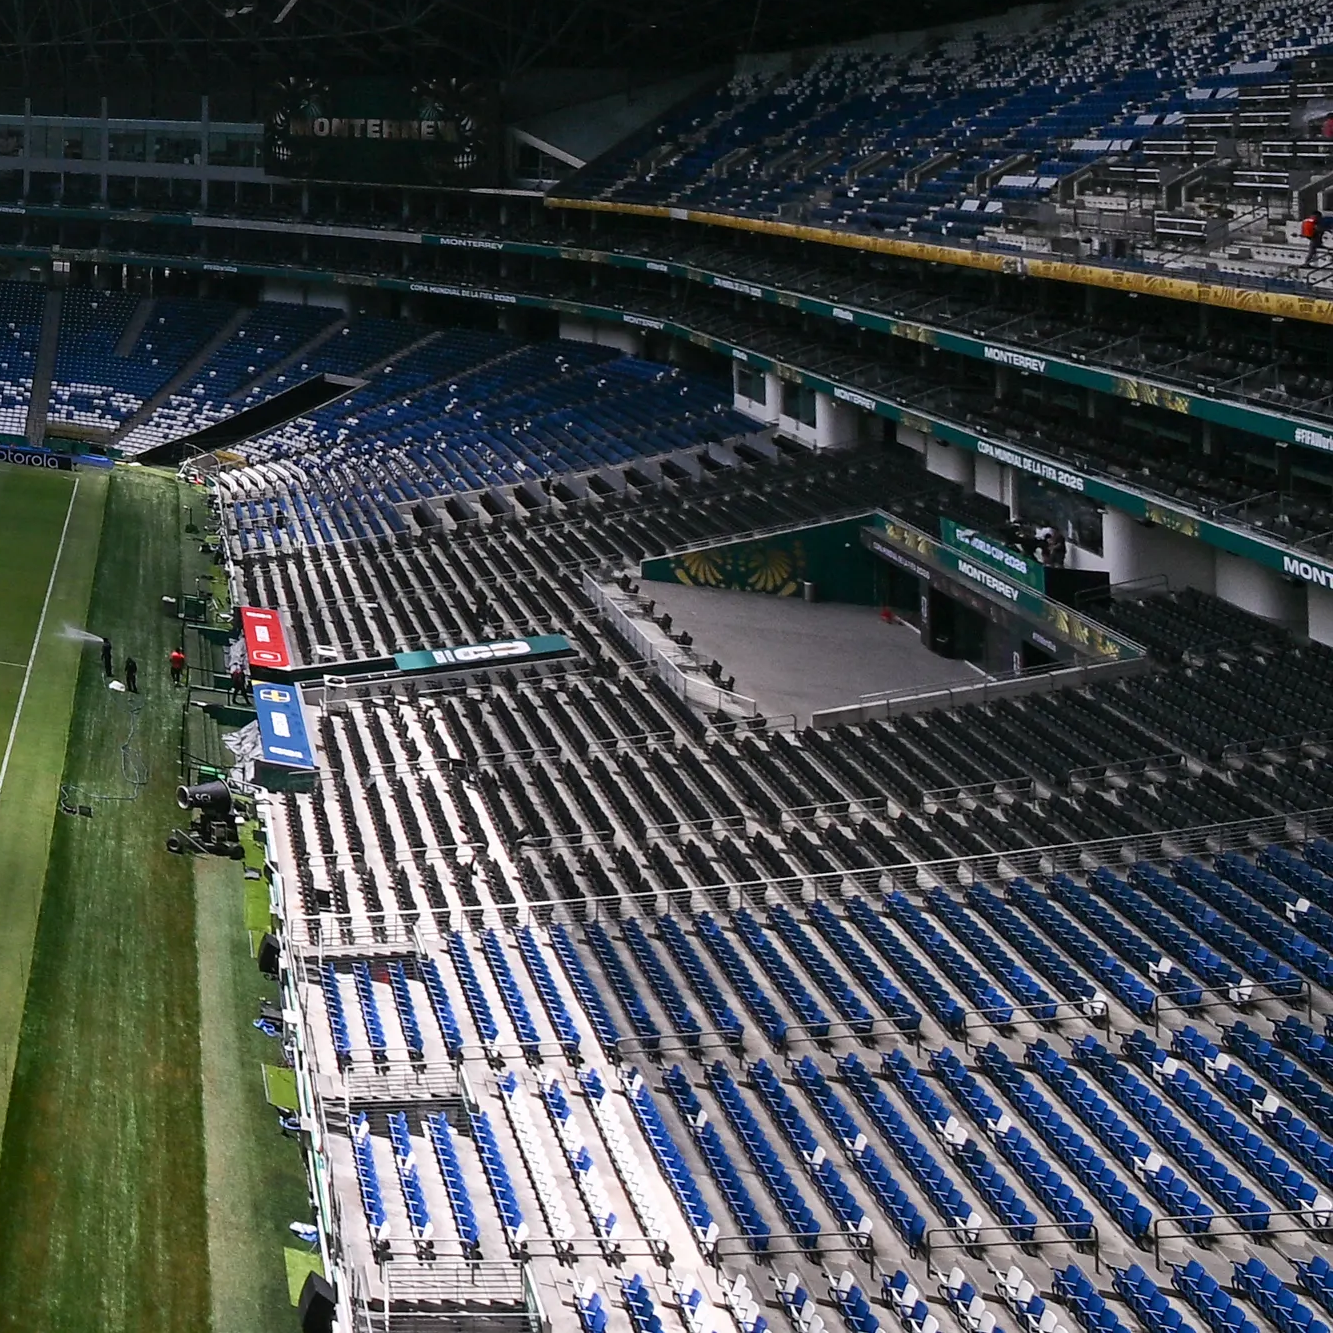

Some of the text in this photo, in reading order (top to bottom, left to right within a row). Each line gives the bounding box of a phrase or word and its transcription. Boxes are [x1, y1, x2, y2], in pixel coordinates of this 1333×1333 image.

[289, 117, 459, 141] MONTERREY
[440, 237, 504, 250] MONTERREY
[984, 346, 1046, 373] MONTERREY
[834, 386, 876, 411] MONTERREY
[977, 441, 1084, 491] COPA MUNDIAL DE LA FIFA 2026
[958, 559, 1020, 601] MONTERREY
